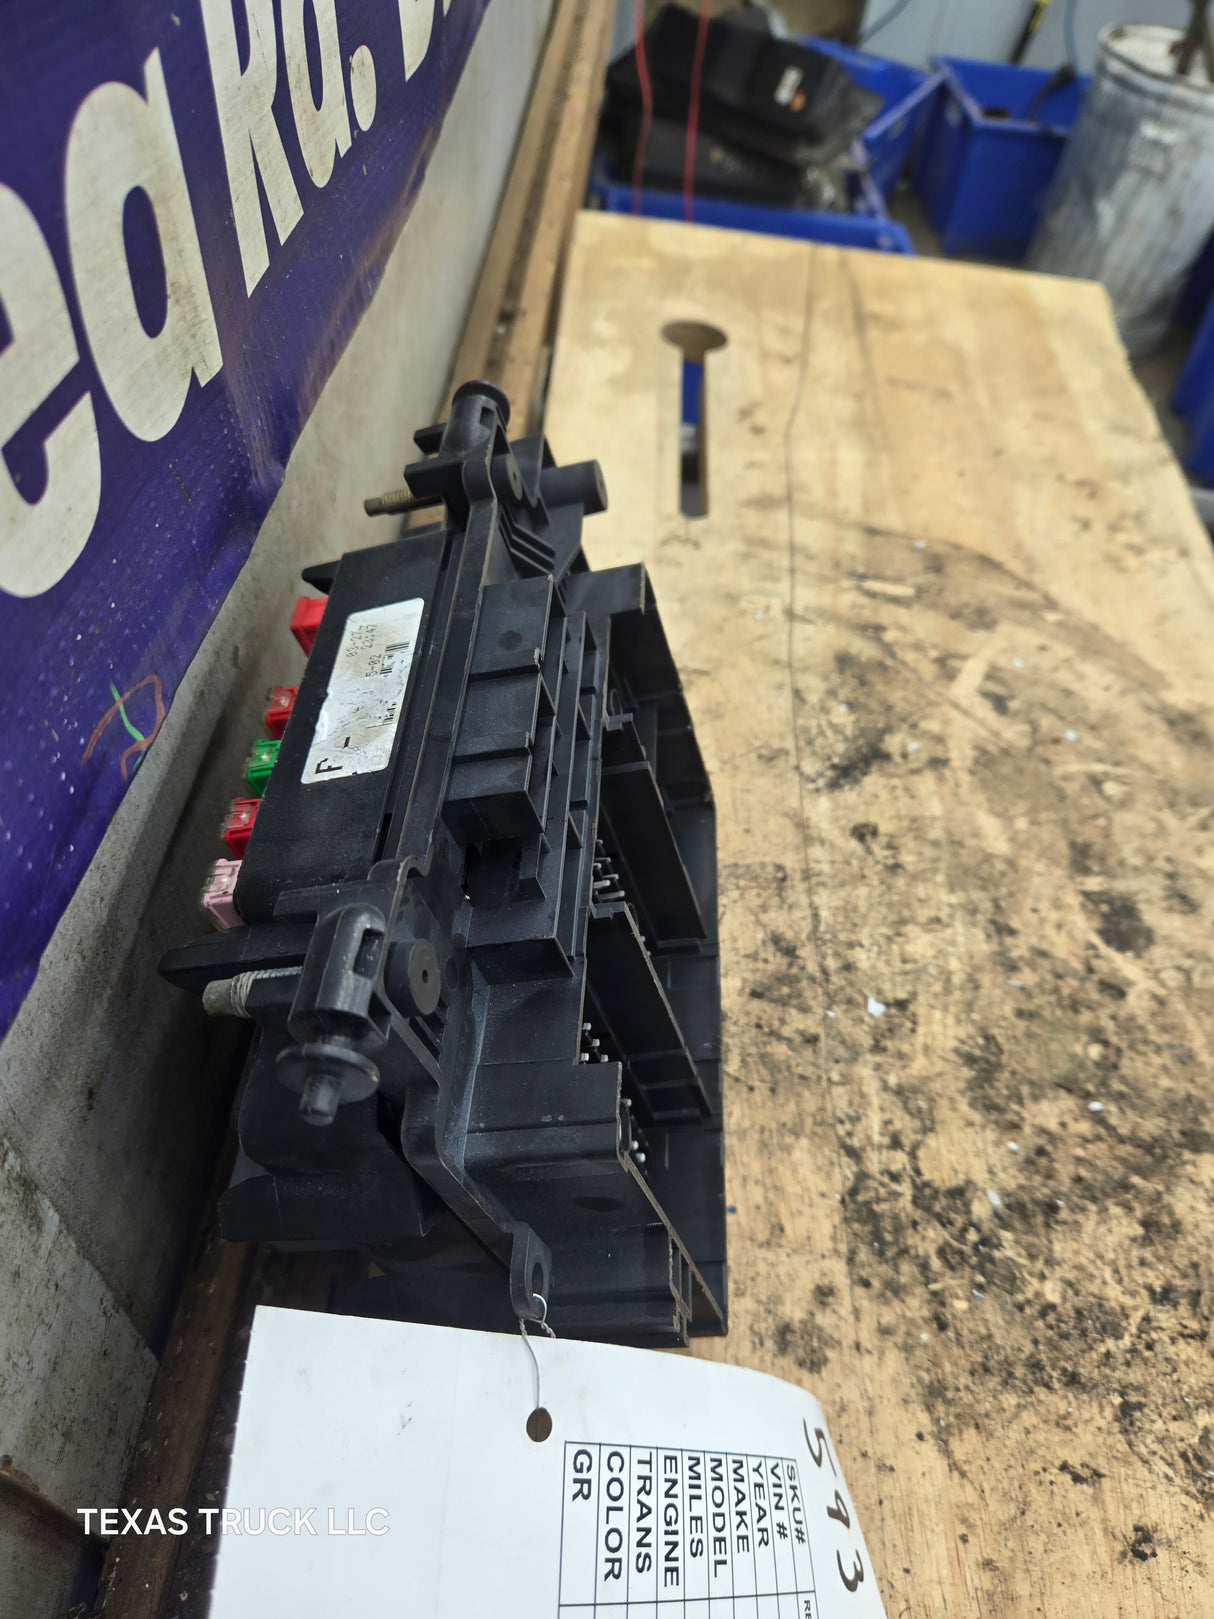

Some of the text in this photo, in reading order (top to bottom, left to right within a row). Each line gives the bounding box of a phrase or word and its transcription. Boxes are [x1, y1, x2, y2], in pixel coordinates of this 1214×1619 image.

[572, 1449, 593, 1502] GR
[603, 1451, 625, 1582] COLOR
[636, 1452, 653, 1574] TRANS
[663, 1455, 680, 1588] ENGINE
[687, 1456, 704, 1559] MILES
[709, 1457, 728, 1579] MODEL
[731, 1459, 750, 1554] MAKE
[752, 1460, 770, 1548] YEAR
[770, 1462, 788, 1540] VIN #
[786, 1465, 806, 1545] SKU#
